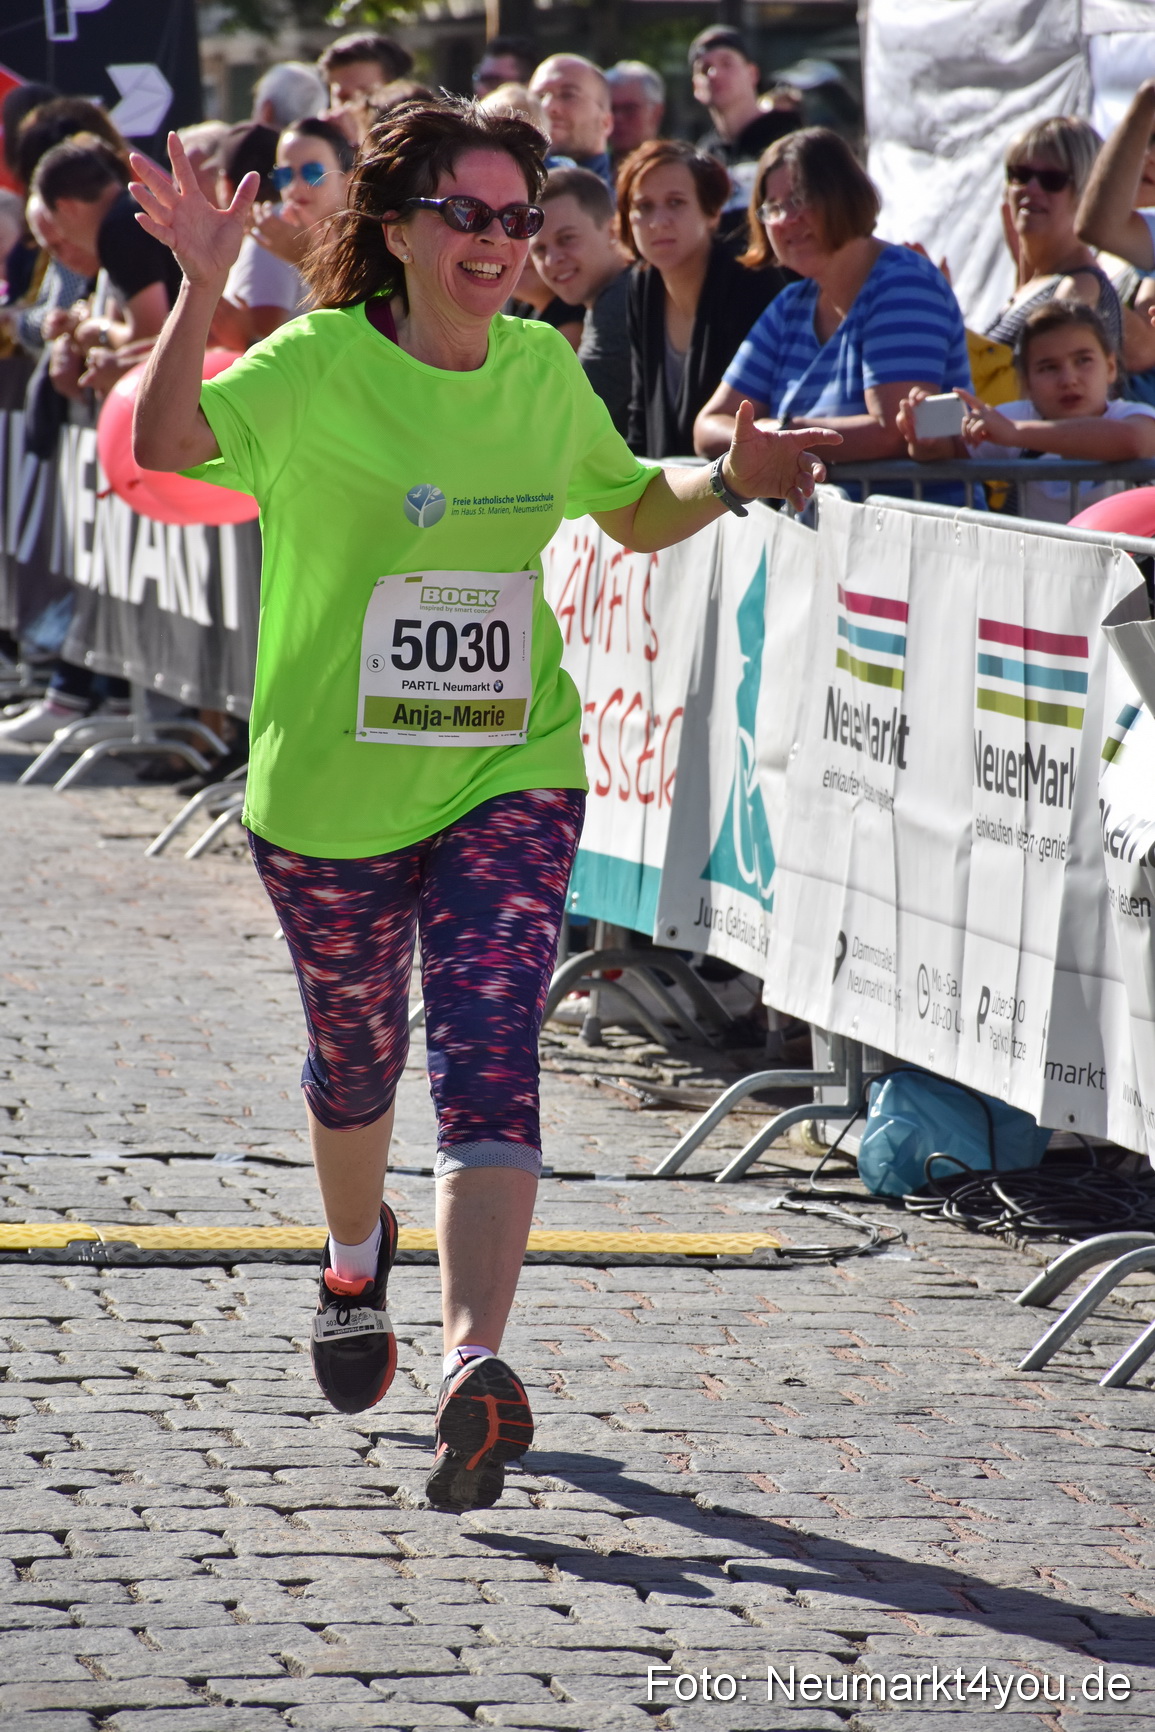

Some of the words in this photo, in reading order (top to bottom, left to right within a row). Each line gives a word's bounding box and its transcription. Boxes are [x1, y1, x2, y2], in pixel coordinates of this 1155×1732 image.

[451, 508, 460, 516] im
[461, 507, 477, 516] Haus
[478, 507, 486, 515] St.
[487, 506, 511, 515] Marien,
[452, 497, 472, 506] Freie
[473, 495, 515, 505] katholische
[516, 493, 554, 502] Volksschule
[420, 586, 501, 608] BOCK
[390, 618, 511, 673] 5030
[401, 679, 440, 691] PARTL
[443, 682, 491, 692] Neumarkt
[392, 703, 506, 731] Anja-Marie
[975, 812, 1013, 847] einkaufen
[1038, 833, 1068, 862] genie
[693, 897, 723, 932] Jura
[1115, 885, 1152, 918] leben
